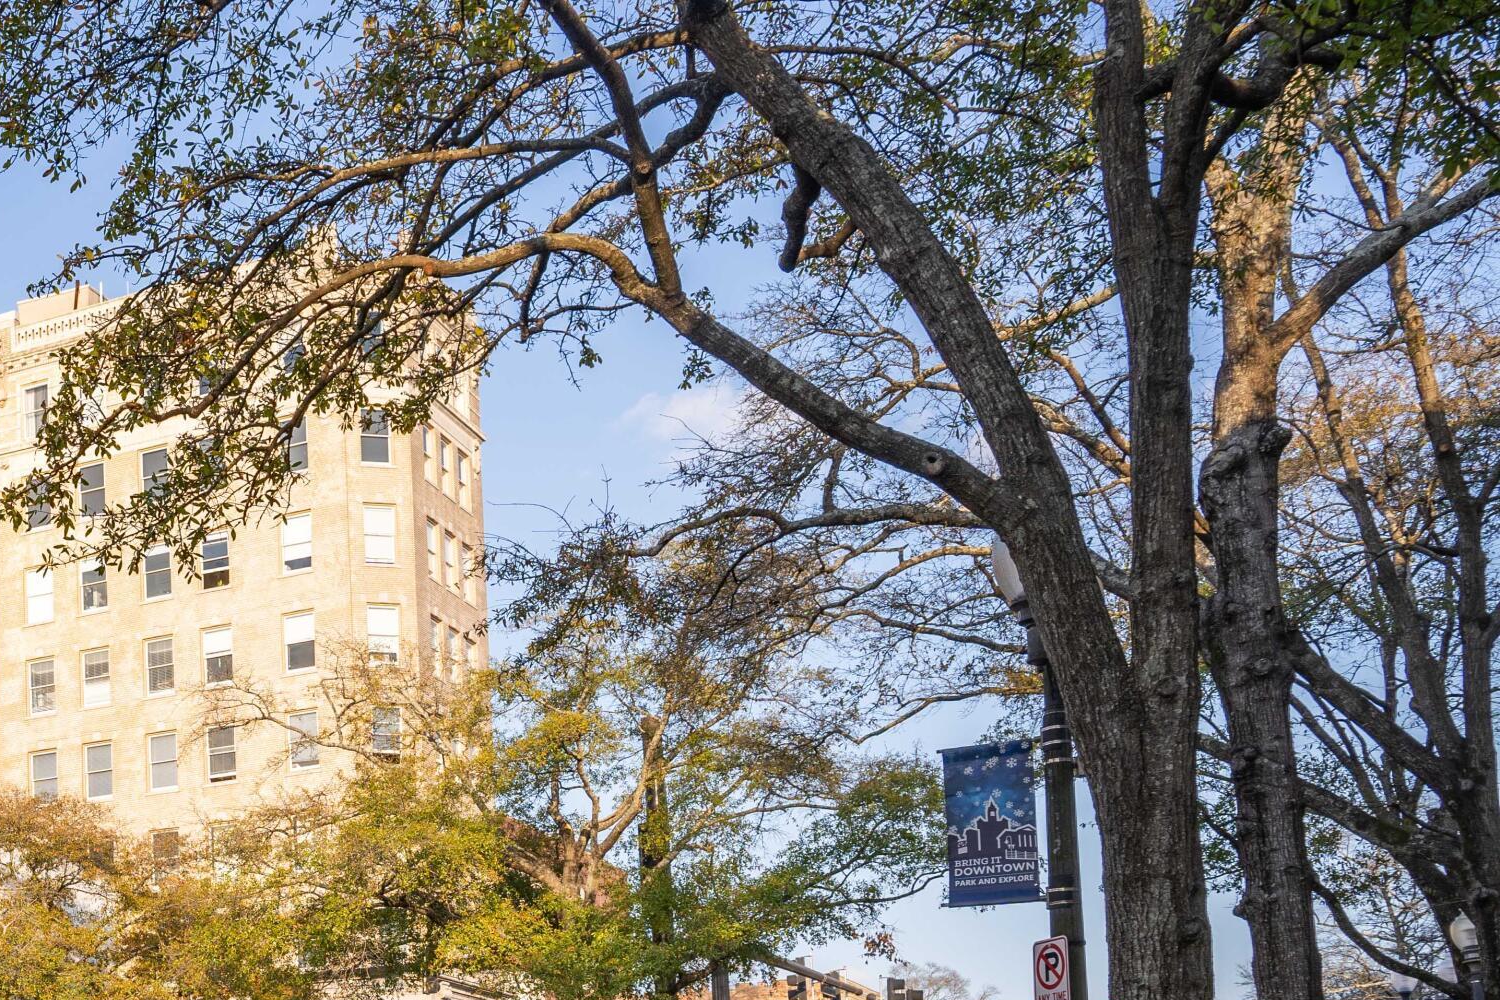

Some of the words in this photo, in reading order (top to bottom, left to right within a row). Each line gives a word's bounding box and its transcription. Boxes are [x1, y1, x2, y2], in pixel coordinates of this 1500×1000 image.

[954, 857, 989, 868] BRING
[991, 856, 1002, 864] IT
[954, 861, 1035, 877] DOWNTOWN
[955, 879, 977, 887] PARK
[978, 877, 997, 885] AND
[998, 874, 1035, 884] EXPLORE
